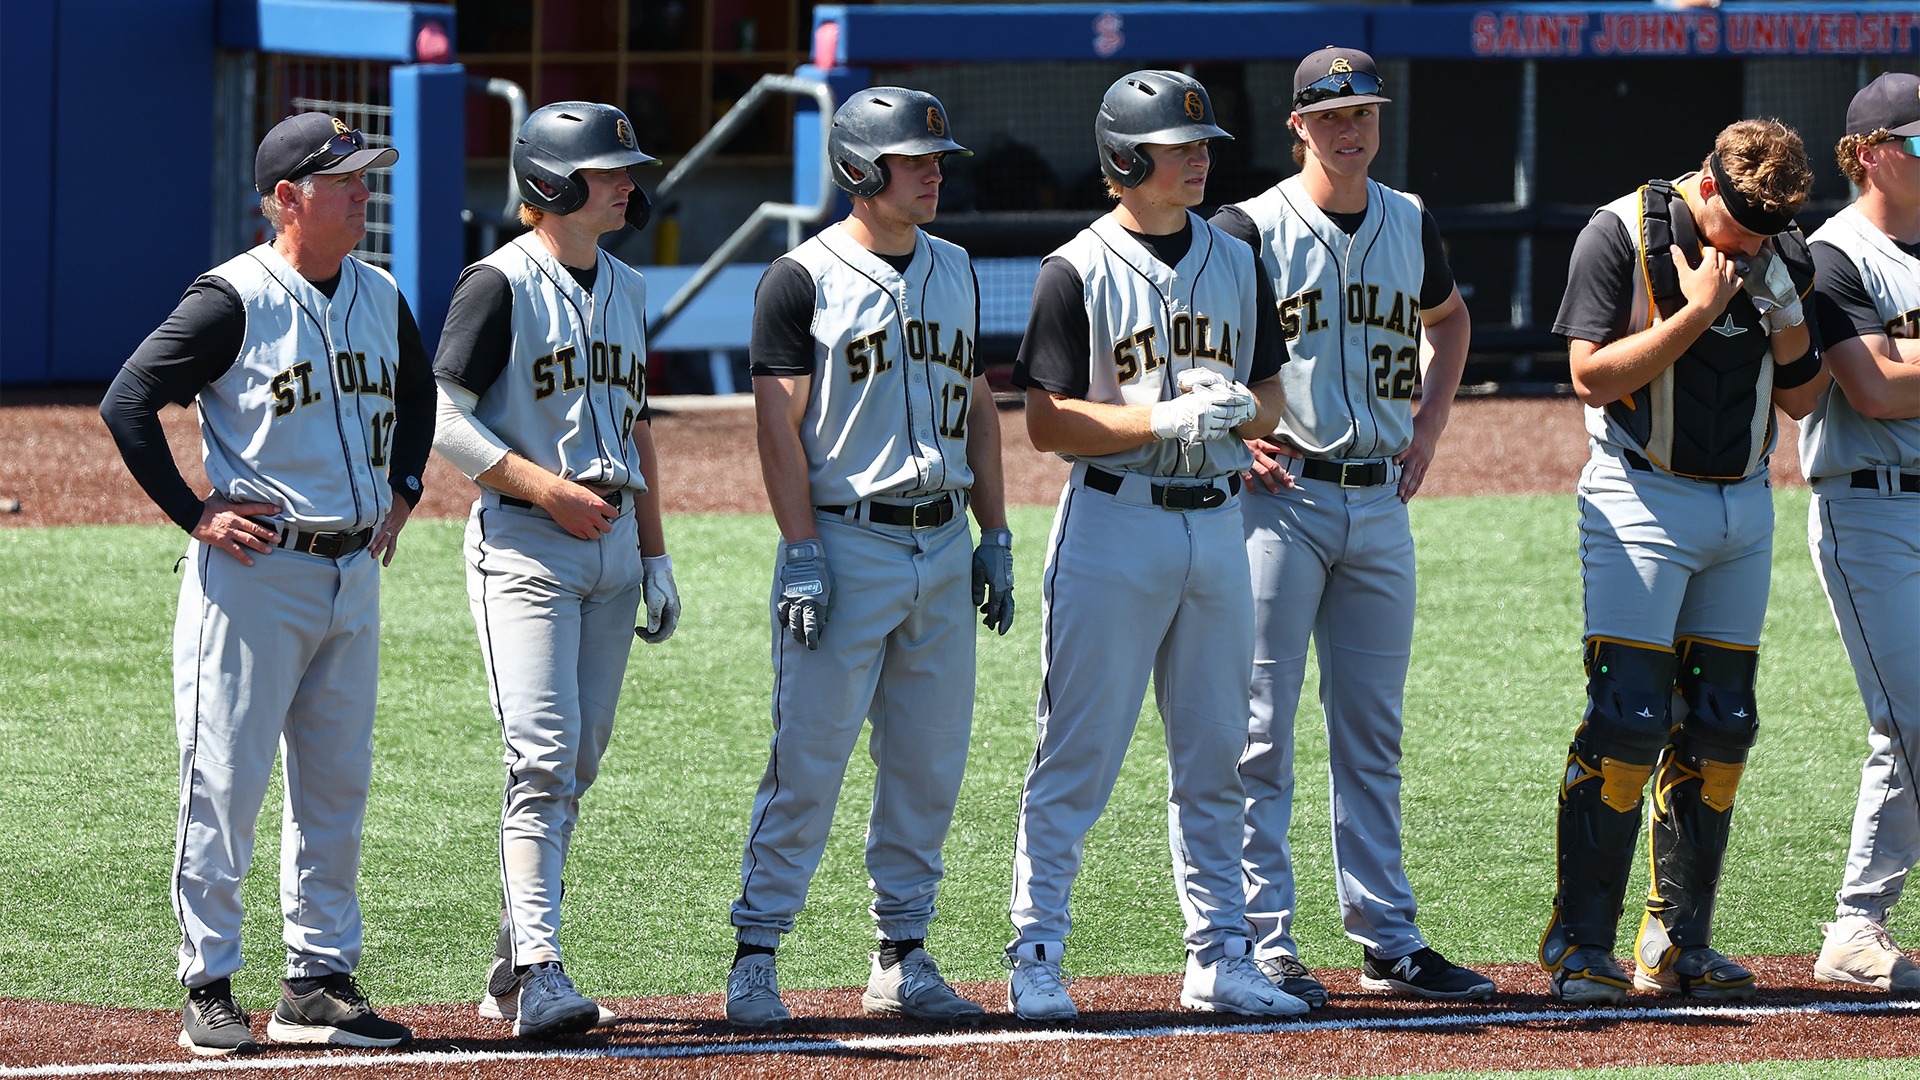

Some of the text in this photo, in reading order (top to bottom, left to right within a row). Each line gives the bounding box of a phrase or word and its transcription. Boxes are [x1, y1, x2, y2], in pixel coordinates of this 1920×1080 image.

[1472, 13, 1920, 54] SAINT JOHN'S UNIVERSIT
[1279, 282, 1420, 342] ST. OLAF
[532, 345, 585, 401] ST.
[845, 328, 893, 384] ST.
[1113, 312, 1241, 384] ST. OLA
[1370, 344, 1417, 401] 22
[271, 351, 399, 419] ST. OLA
[939, 382, 968, 439] 17
